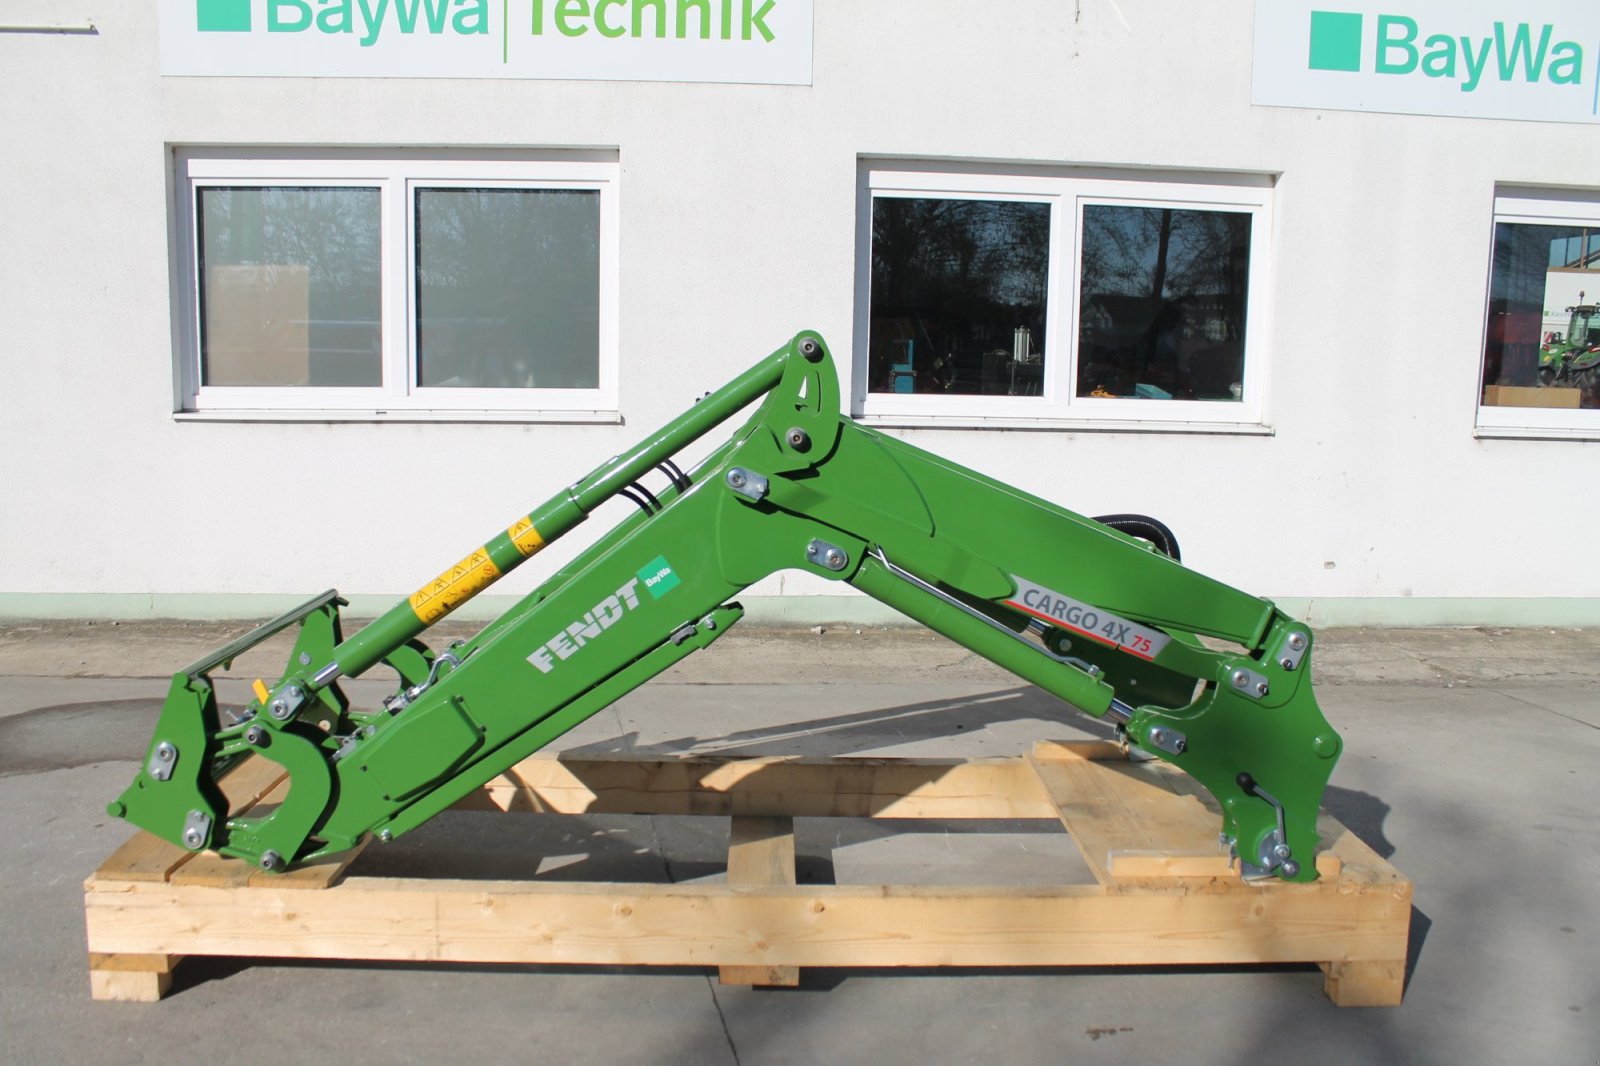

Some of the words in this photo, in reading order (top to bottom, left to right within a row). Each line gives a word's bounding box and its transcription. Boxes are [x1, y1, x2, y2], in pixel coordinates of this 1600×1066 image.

[1375, 13, 1584, 92] BayWa
[645, 567, 671, 587] BayWa
[525, 576, 640, 674] FENDT
[1023, 589, 1099, 630] CARGO
[1101, 620, 1132, 644] 4X
[1130, 634, 1153, 652] 75
